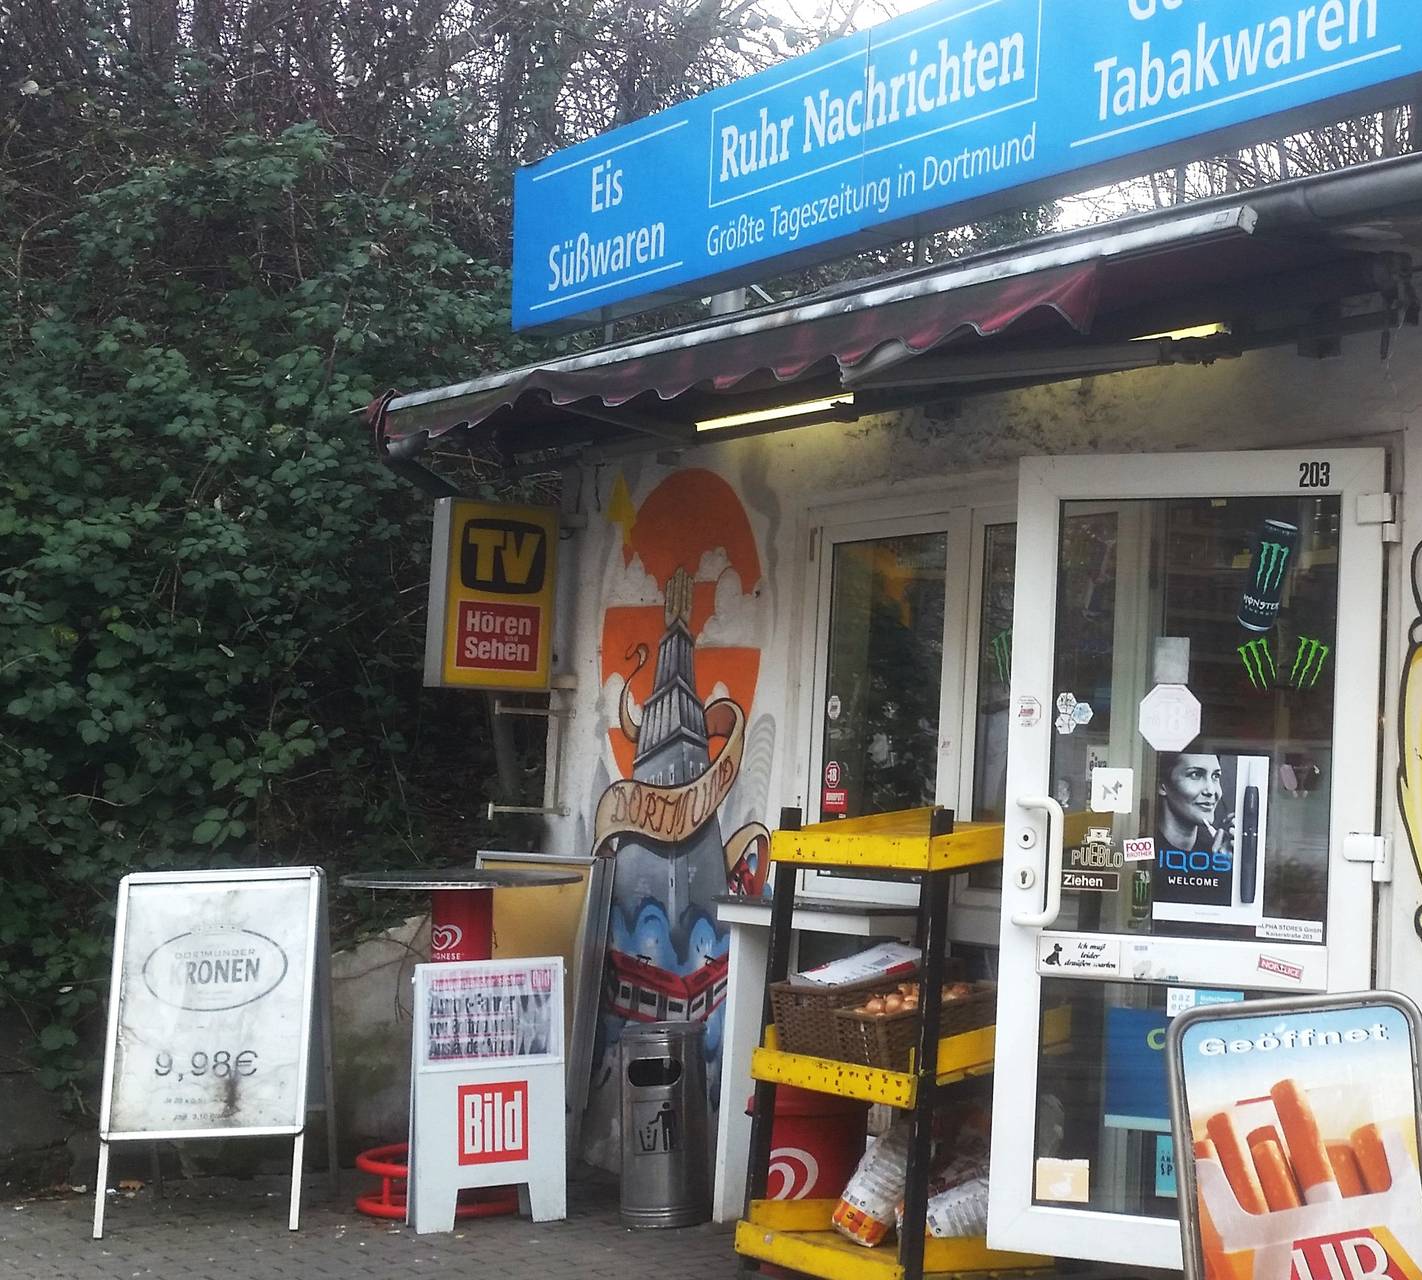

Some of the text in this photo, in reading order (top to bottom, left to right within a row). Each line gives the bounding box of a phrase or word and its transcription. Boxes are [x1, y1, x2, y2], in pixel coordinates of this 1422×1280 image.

[1094, 0, 1377, 121] Tabakwaren
[719, 31, 1025, 183] Ruhr Nachrichten
[590, 160, 624, 214] Eis
[706, 121, 1037, 258] Größte Tageszeitung in Dortmund
[548, 220, 667, 292] Süßwaren
[1299, 462, 1330, 487] 203
[468, 529, 541, 585] TV
[466, 610, 531, 636] Hören
[464, 636, 530, 662] Sehen
[610, 756, 734, 835] DORTMUND
[1071, 843, 1124, 868] PUEBLO
[1126, 841, 1152, 852] FOOD
[1159, 850, 1232, 873] IQOS
[1063, 874, 1103, 887] Ziehen
[1168, 876, 1219, 887] WELCOME
[1199, 1023, 1390, 1056] Geöffnet
[155, 1049, 259, 1082] 9,98€
[463, 1091, 523, 1155] Bild
